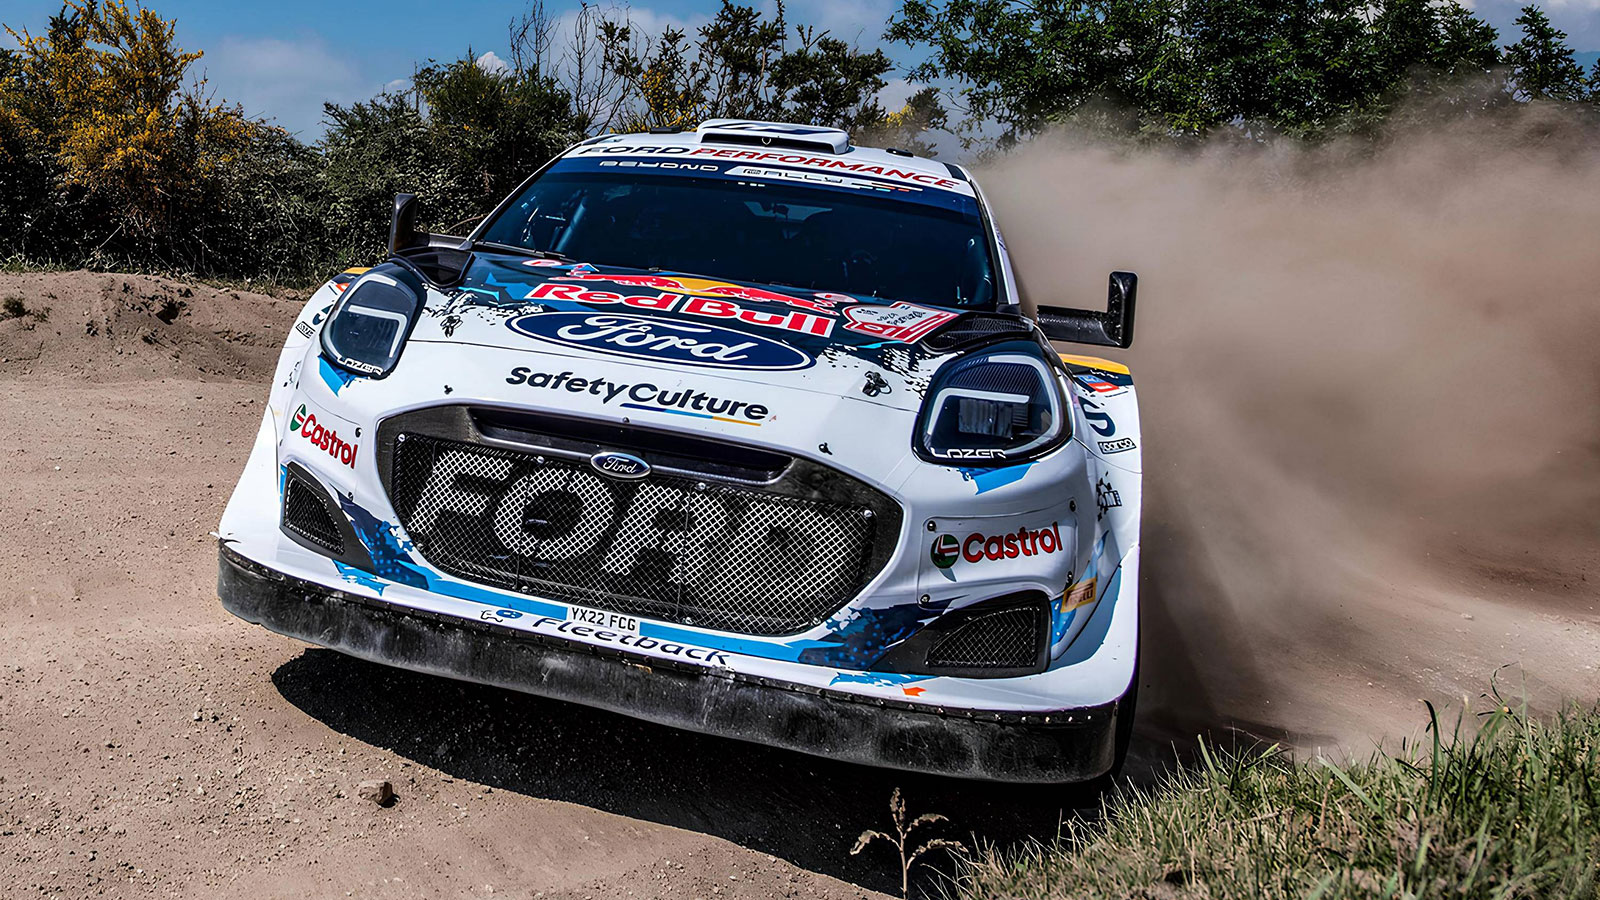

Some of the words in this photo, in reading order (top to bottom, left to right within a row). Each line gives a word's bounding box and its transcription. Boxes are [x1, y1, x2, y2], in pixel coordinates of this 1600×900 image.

[578, 146, 690, 155] FORD
[690, 148, 961, 189] PERFORMANCE
[600, 160, 719, 172] BEYOND
[523, 283, 684, 312] Red
[678, 296, 837, 338] Bull
[557, 315, 758, 361] Ford
[505, 366, 769, 420] SafetyCulture
[301, 414, 359, 470] Castrol
[602, 456, 638, 474] Ford
[406, 450, 855, 601] FORD
[962, 521, 1063, 563] Castrol
[532, 616, 731, 666] Fleetback
[572, 607, 605, 626] YX22
[609, 612, 637, 632] FCG
